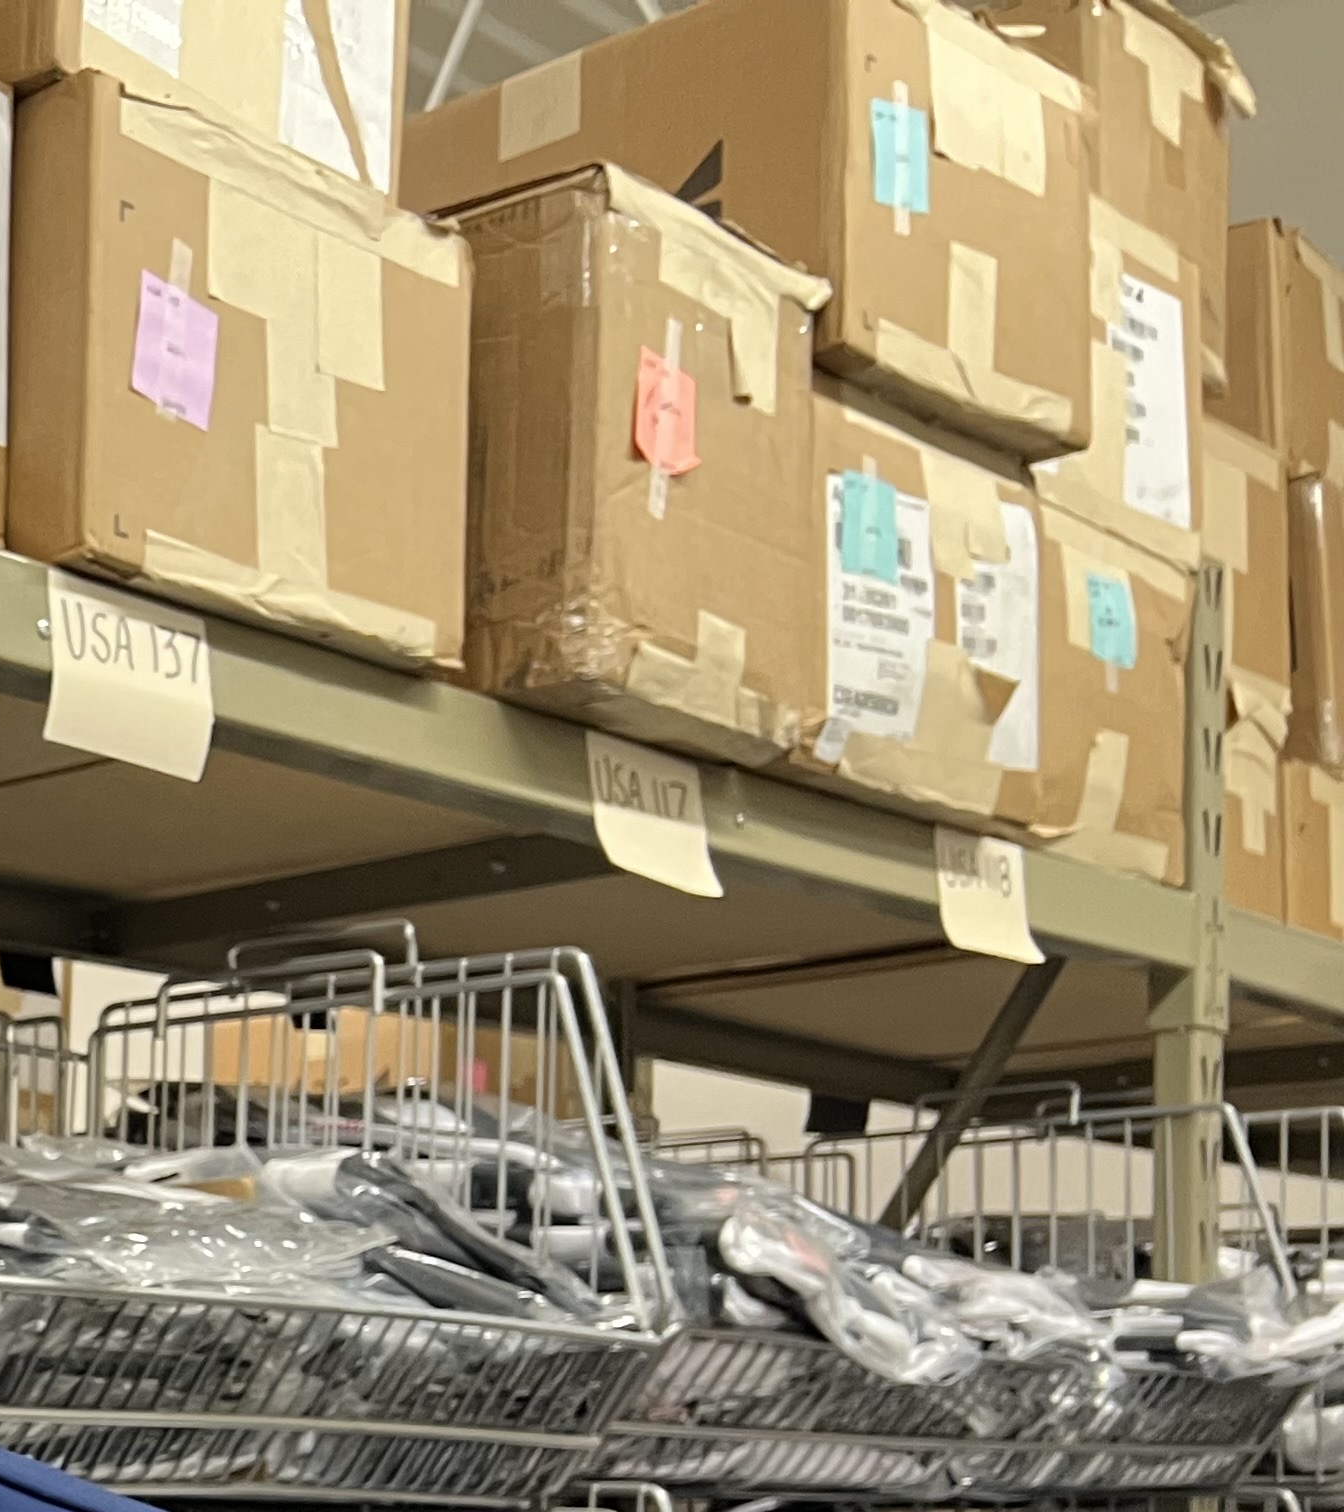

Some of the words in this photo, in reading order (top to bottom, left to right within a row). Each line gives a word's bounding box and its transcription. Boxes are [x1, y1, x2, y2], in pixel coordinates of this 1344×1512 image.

[61, 597, 135, 672] USA
[149, 620, 202, 684] 137
[593, 754, 647, 812] USA
[650, 776, 688, 819] 117
